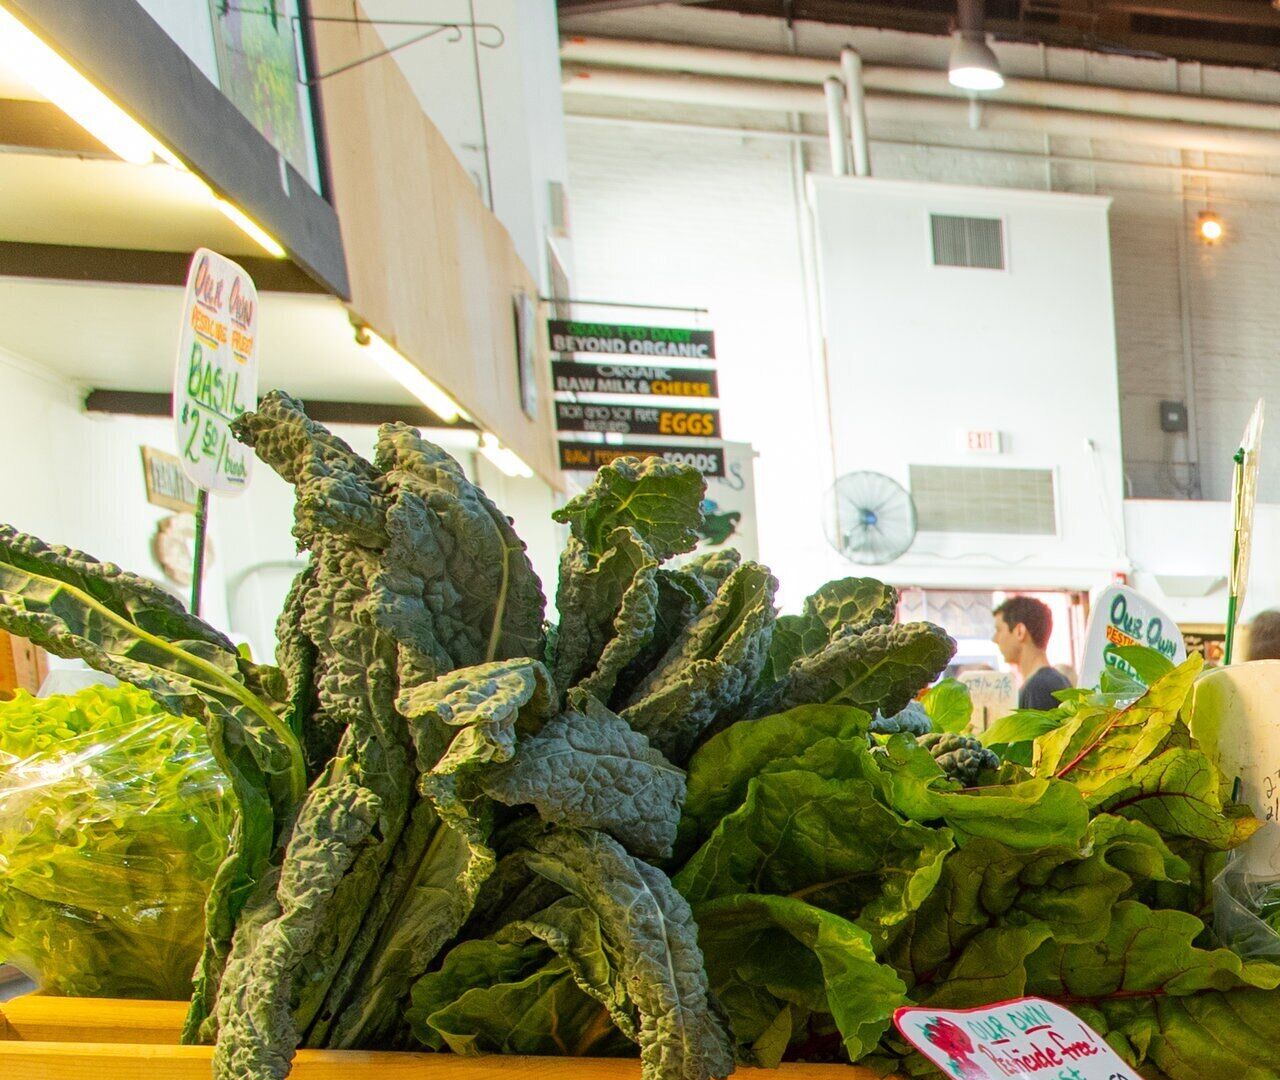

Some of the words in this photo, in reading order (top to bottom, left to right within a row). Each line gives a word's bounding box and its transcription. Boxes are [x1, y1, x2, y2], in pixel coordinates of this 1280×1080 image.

[553, 335, 626, 353] BEYOND
[629, 341, 708, 358] ORGANIC
[187, 343, 245, 416] BASIL
[597, 365, 672, 380] ORGANIC
[557, 377, 595, 391] RAW
[602, 379, 636, 393] MILK
[640, 381, 650, 393] &
[651, 381, 710, 397] CHEESE
[659, 411, 714, 436] EGGS
